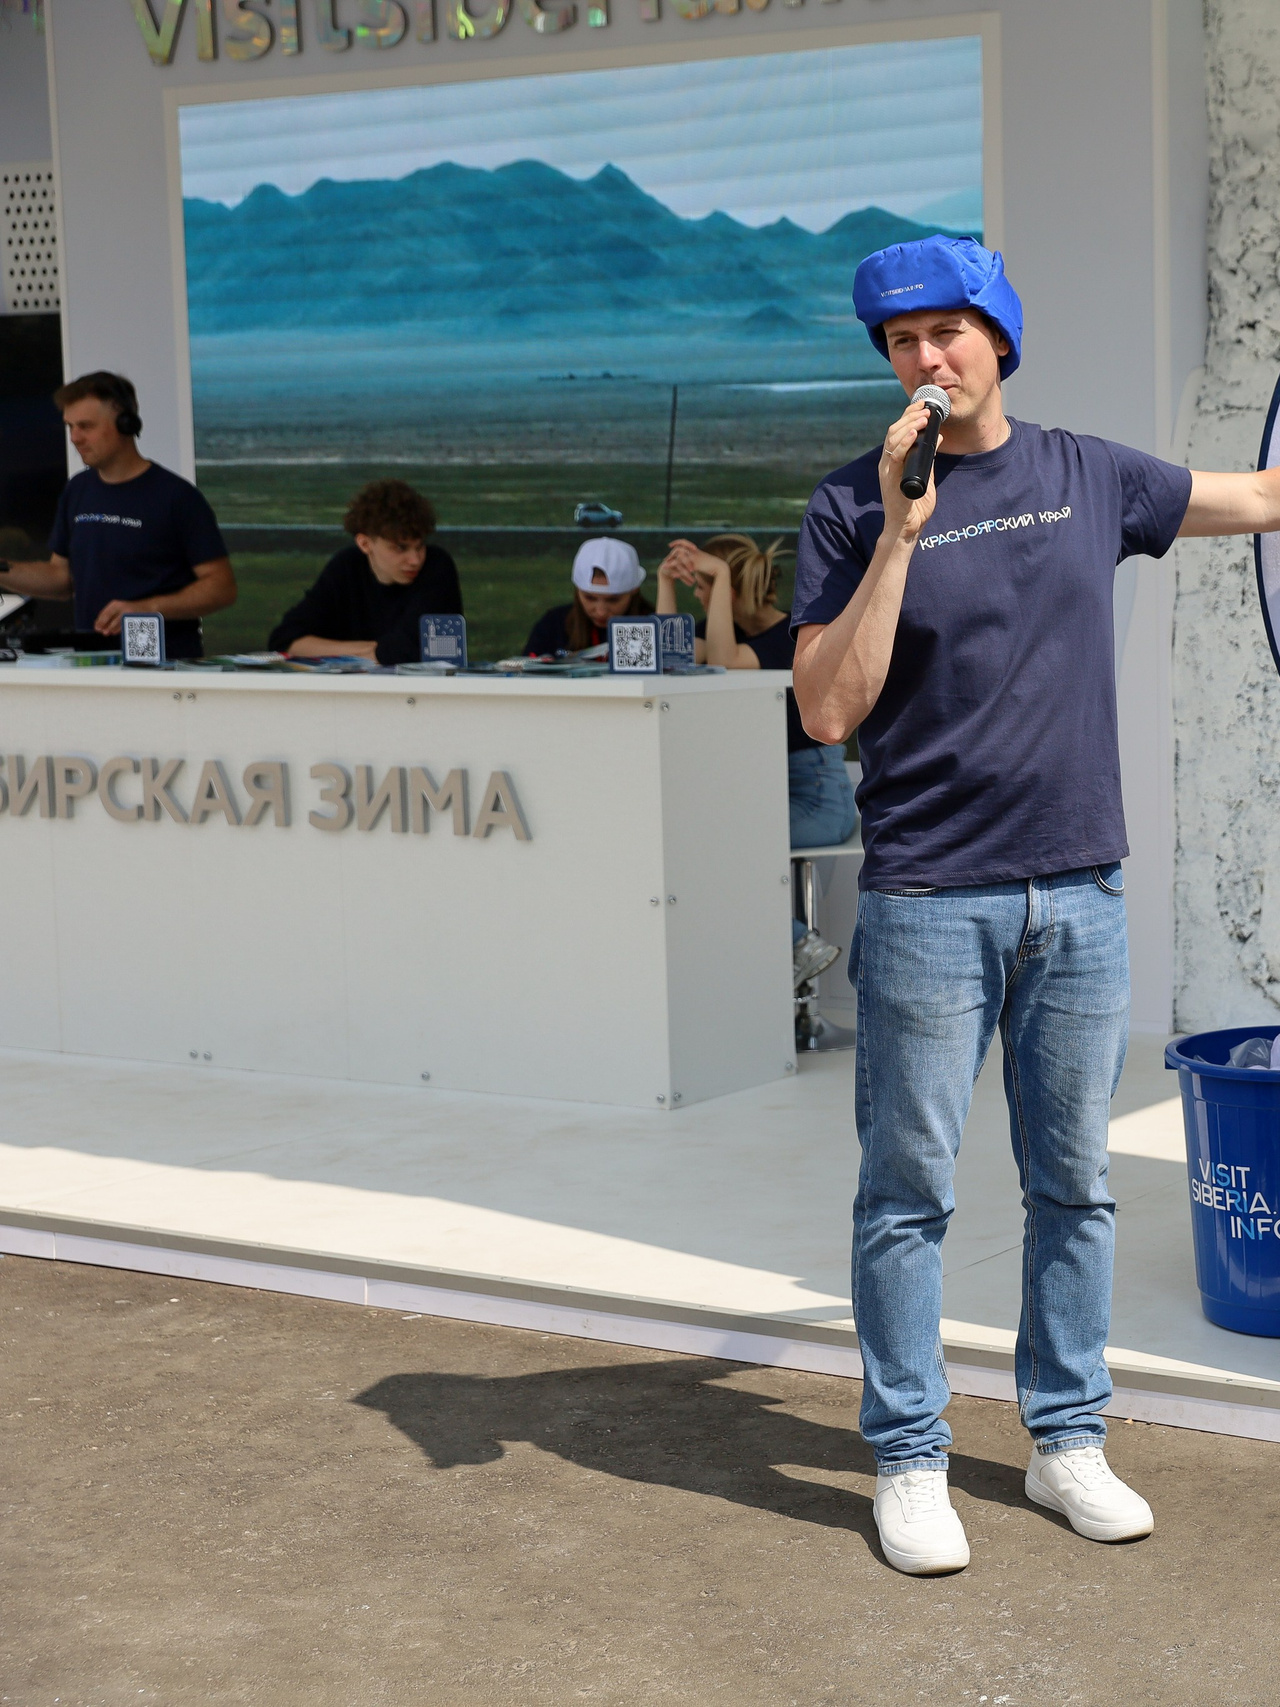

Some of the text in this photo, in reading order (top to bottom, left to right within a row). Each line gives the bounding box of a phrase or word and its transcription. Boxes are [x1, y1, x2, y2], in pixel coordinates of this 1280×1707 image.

[919, 505, 1072, 551] КРАСНОЯРСКИЙ КРАЙ
[0, 754, 533, 841] ИРСКАЯ ЗИМА
[1198, 1157, 1251, 1189] VISIT
[1191, 1177, 1277, 1215] SIBERIA.
